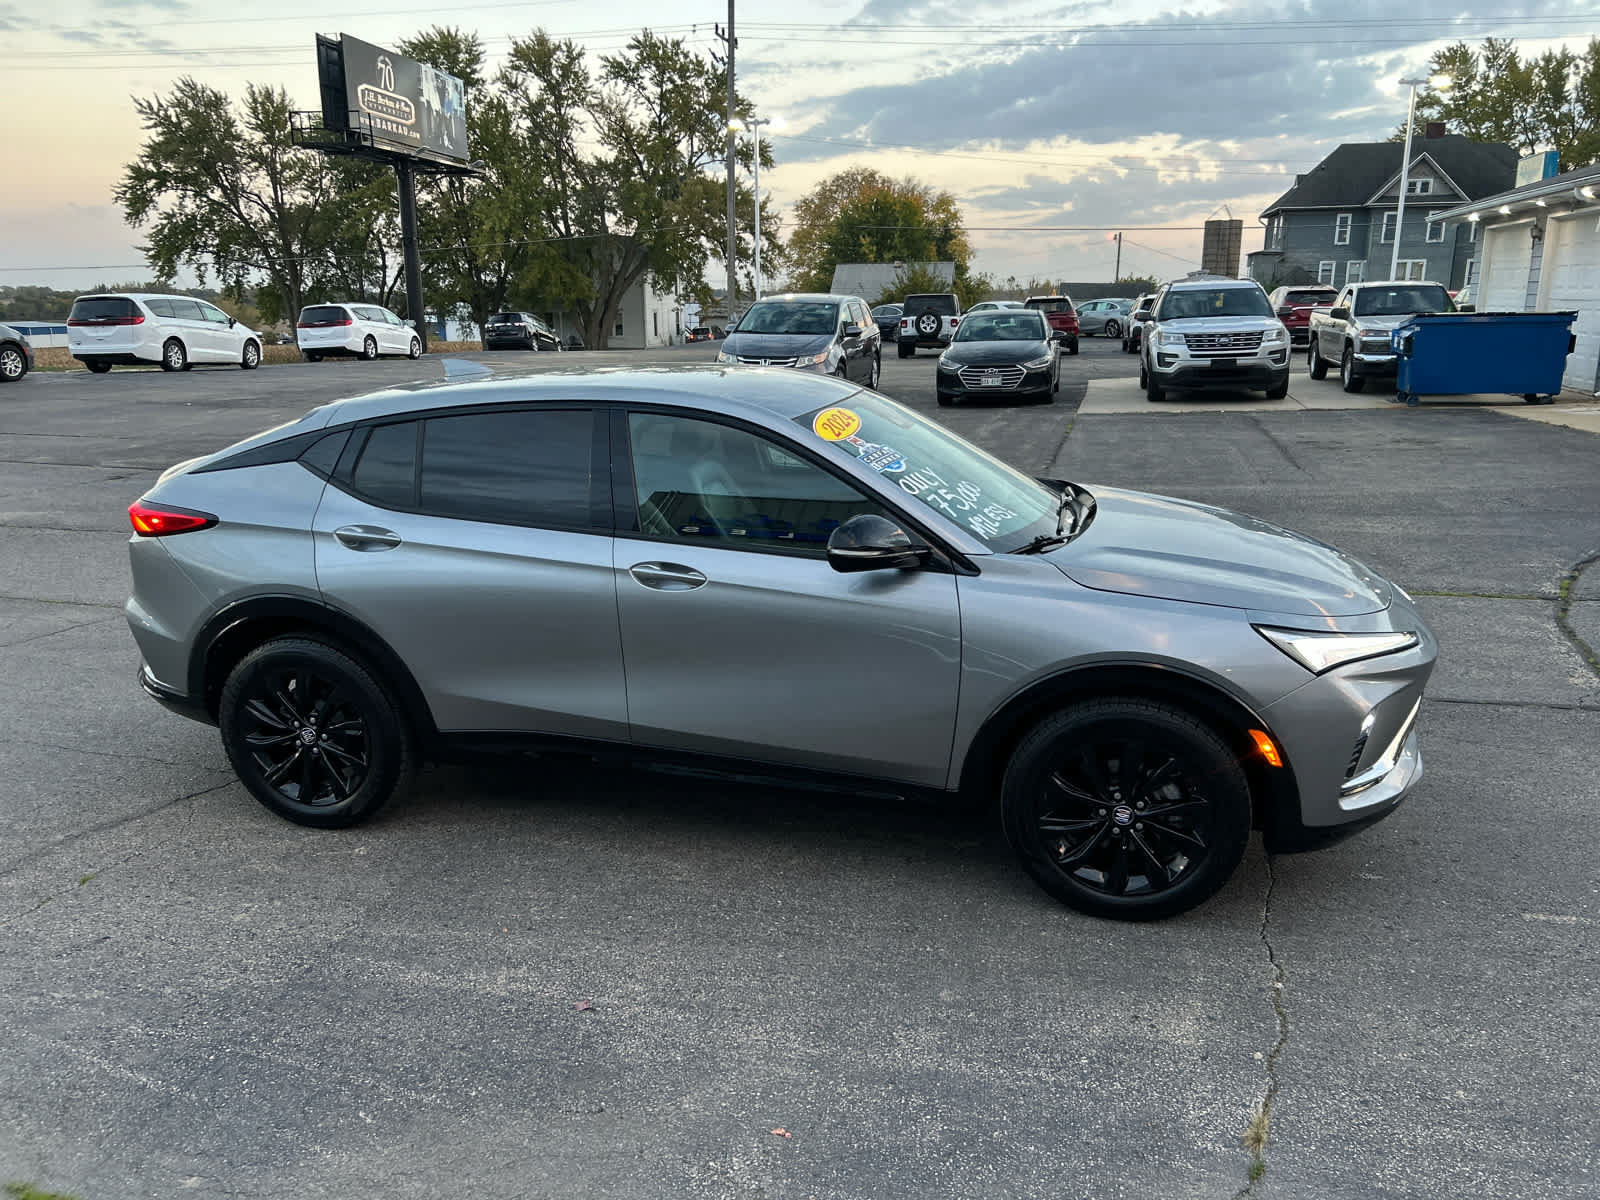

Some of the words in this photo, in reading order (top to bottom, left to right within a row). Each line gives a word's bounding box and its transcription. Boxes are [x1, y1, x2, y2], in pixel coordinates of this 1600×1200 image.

[377, 62, 394, 91] 70
[821, 409, 856, 438] 2024
[898, 466, 949, 495] ONLY
